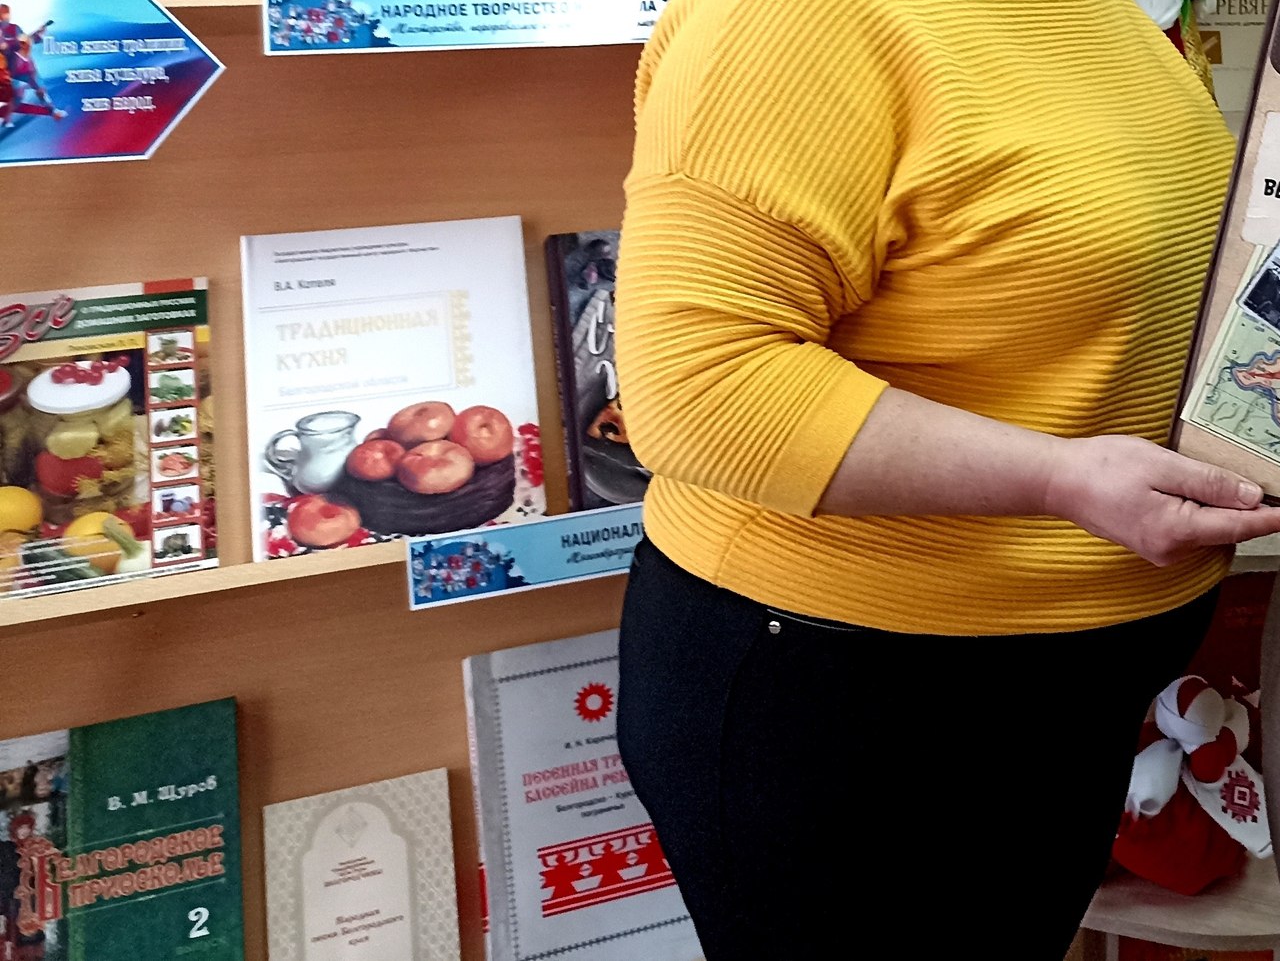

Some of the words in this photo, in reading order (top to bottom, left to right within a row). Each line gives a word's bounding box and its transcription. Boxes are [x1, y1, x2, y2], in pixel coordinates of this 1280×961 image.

[381, 2, 468, 18] НАРОДНОЕ
[276, 309, 438, 341] ТРАДИЦИОННАЯ
[276, 347, 347, 371] КУХНЯ
[522, 759, 598, 786] ПЕСЕННАЯ
[525, 776, 599, 803] БАССЕЙНА
[602, 769, 629, 786] РЕК
[107, 796, 126, 811] В.
[131, 790, 153, 807] М.
[188, 907, 210, 939] 2
